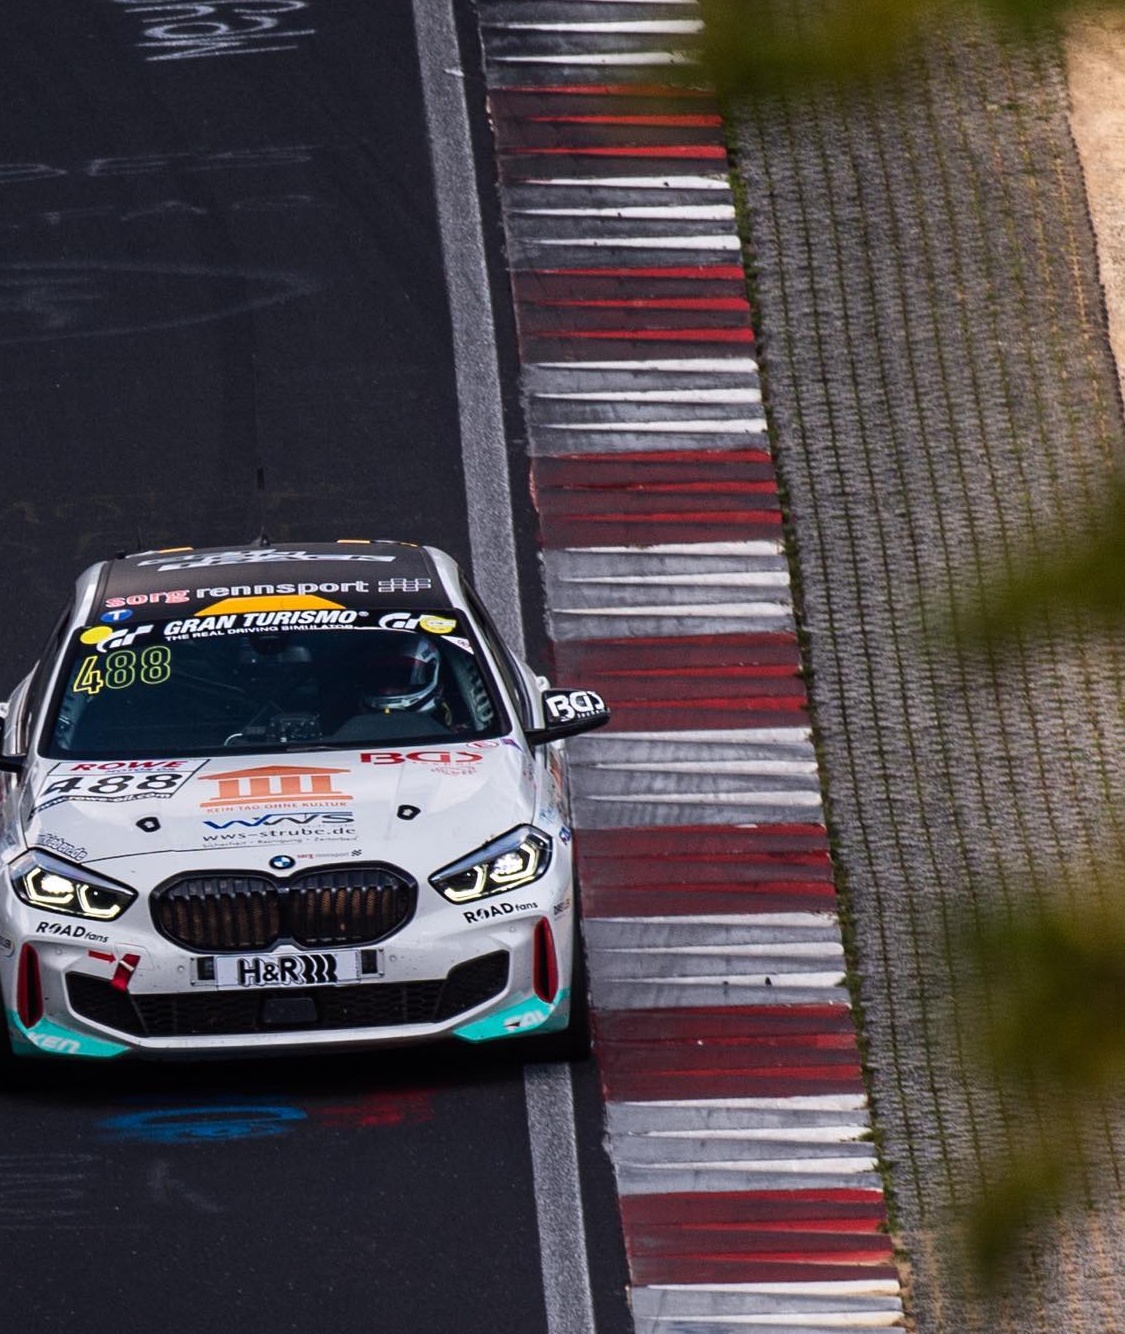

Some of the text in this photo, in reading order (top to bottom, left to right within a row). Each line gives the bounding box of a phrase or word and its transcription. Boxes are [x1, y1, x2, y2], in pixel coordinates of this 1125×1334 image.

[105, 580, 369, 609] sorg rennsport
[164, 616, 240, 636] GRAN
[165, 624, 354, 642] THE REAL DRIVING SIMULATOR
[73, 645, 172, 695] 488
[71, 760, 188, 772] ROWE
[42, 774, 183, 795] 488
[207, 805, 233, 814] KEIN
[264, 802, 298, 810] OHNE
[203, 827, 356, 842] wws-strube.de
[238, 956, 302, 986] H&R
